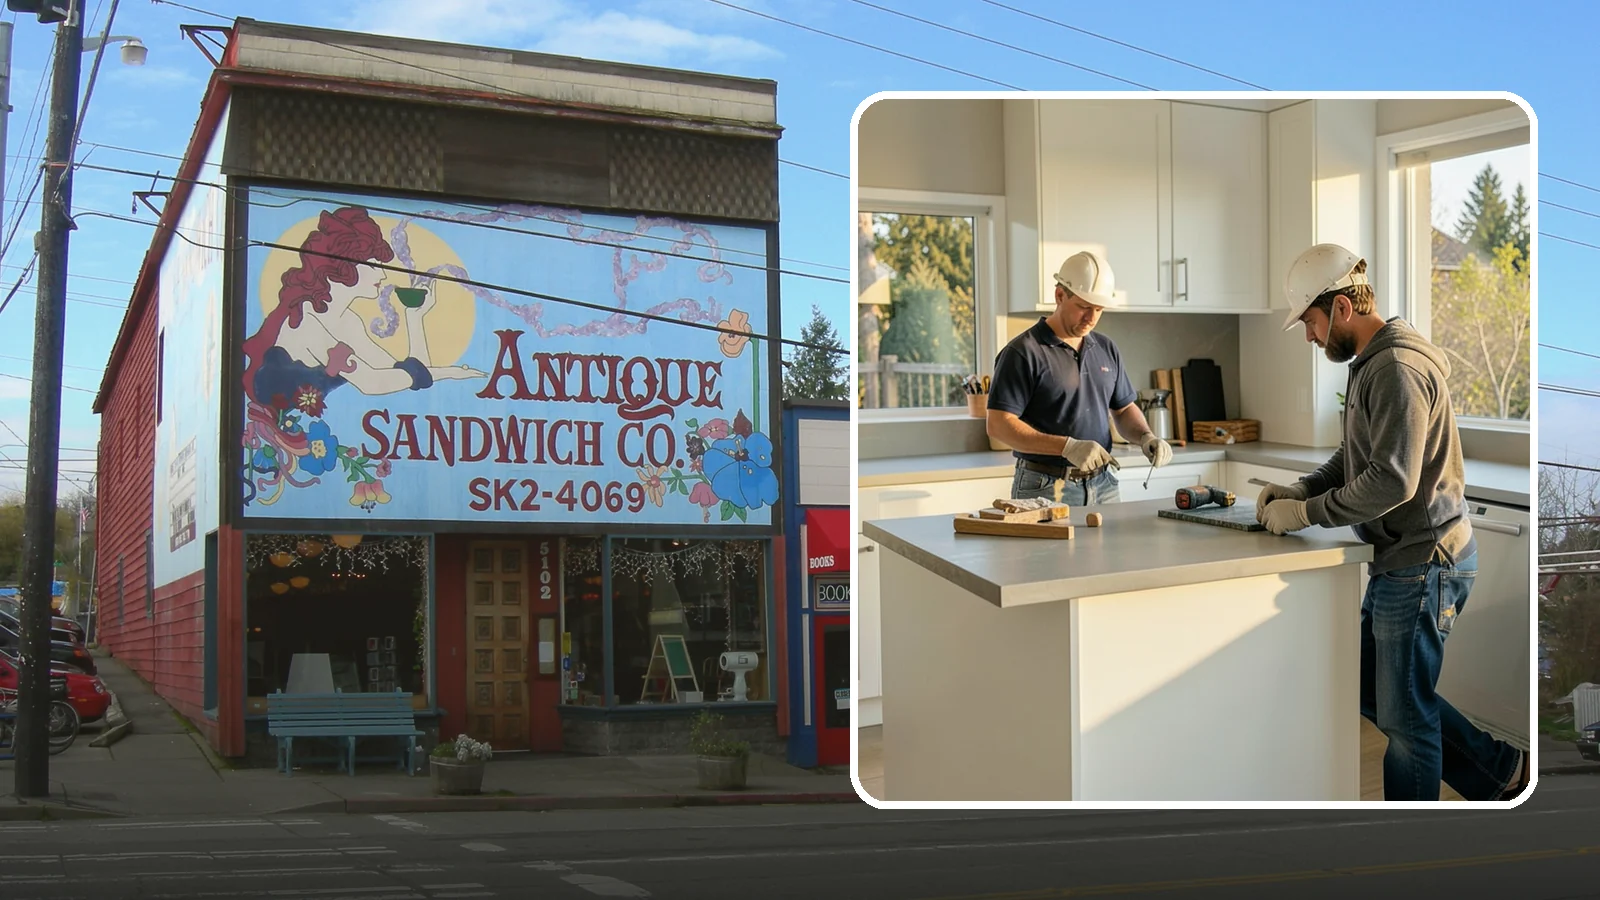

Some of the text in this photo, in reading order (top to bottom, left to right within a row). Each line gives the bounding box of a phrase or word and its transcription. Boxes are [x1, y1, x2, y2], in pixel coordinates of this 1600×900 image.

[475, 329, 723, 420] ANTIQUE
[361, 408, 685, 468] SANDWICH CO.
[468, 477, 646, 513] SK2-4069
[540, 541, 551, 600] 5102
[809, 555, 835, 569] BOOKS
